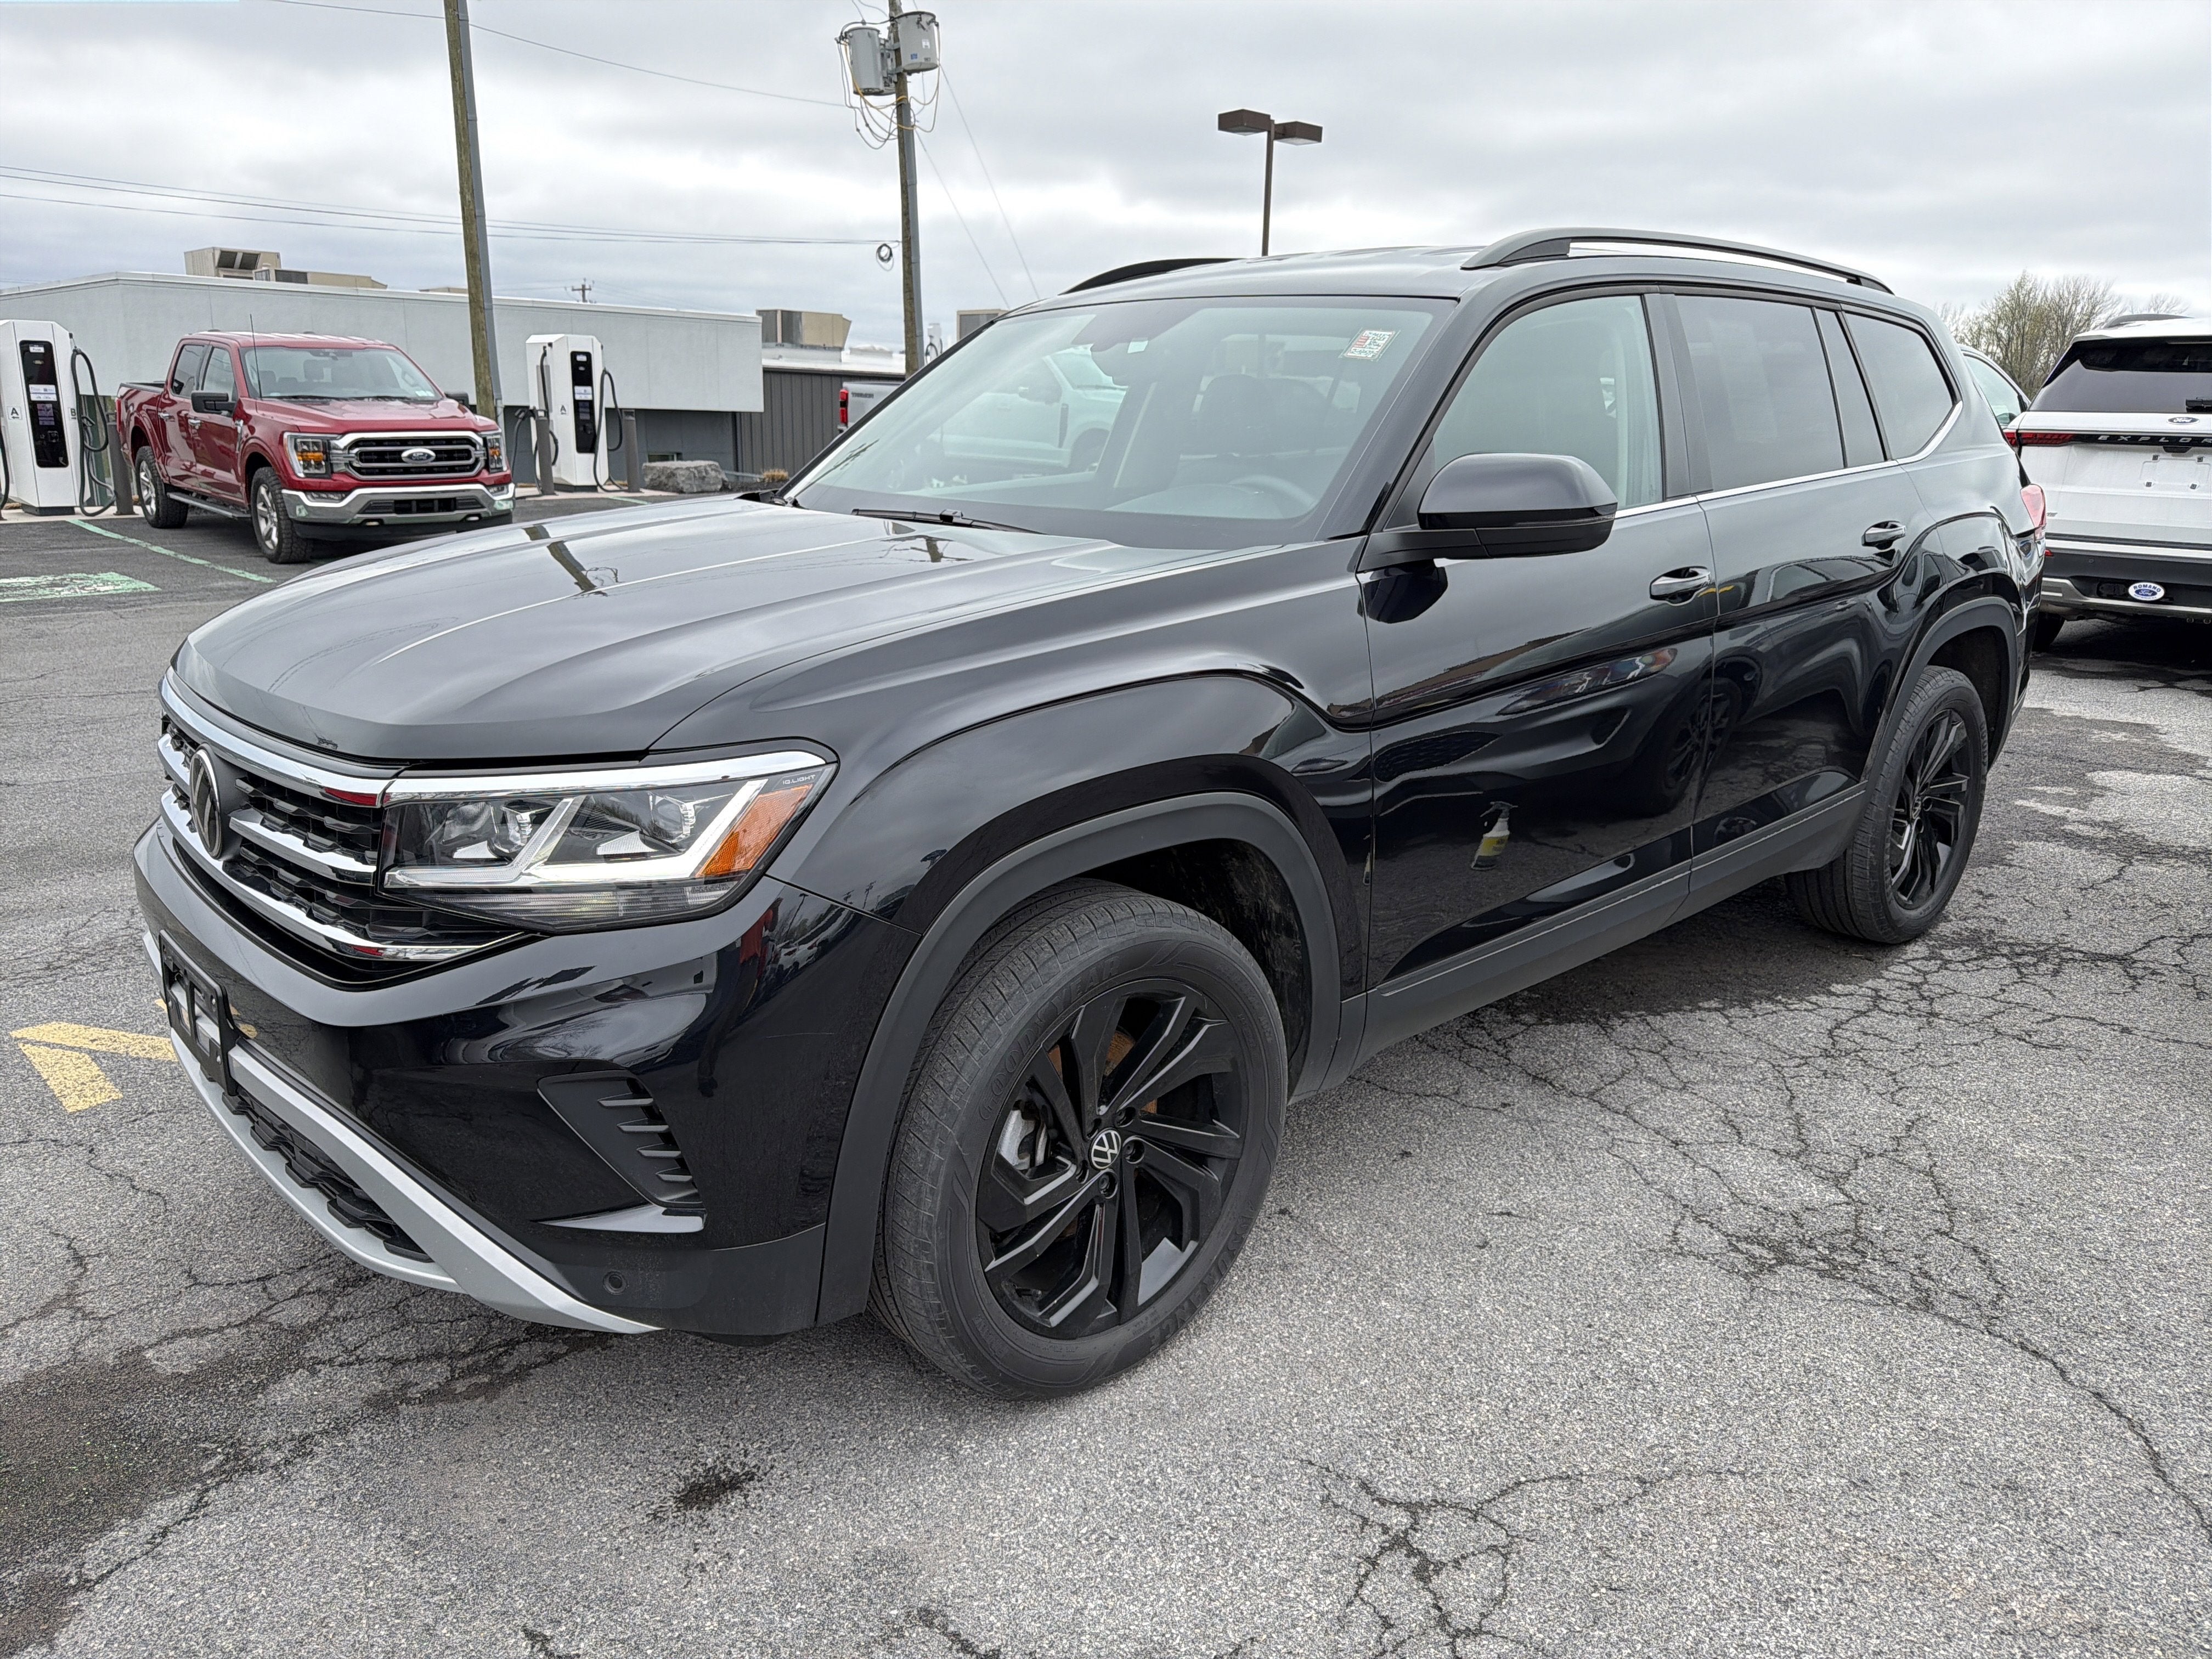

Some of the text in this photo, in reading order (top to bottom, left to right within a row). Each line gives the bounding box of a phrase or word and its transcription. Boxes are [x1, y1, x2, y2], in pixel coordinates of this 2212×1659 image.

[10, 408, 19, 416] A
[71, 408, 76, 416] B
[2097, 435, 2212, 443] EXPLOR
[2133, 584, 2161, 592] ROMANO
[782, 774, 816, 785] IQ.LIGHT
[1091, 1130, 1121, 1169] VW
